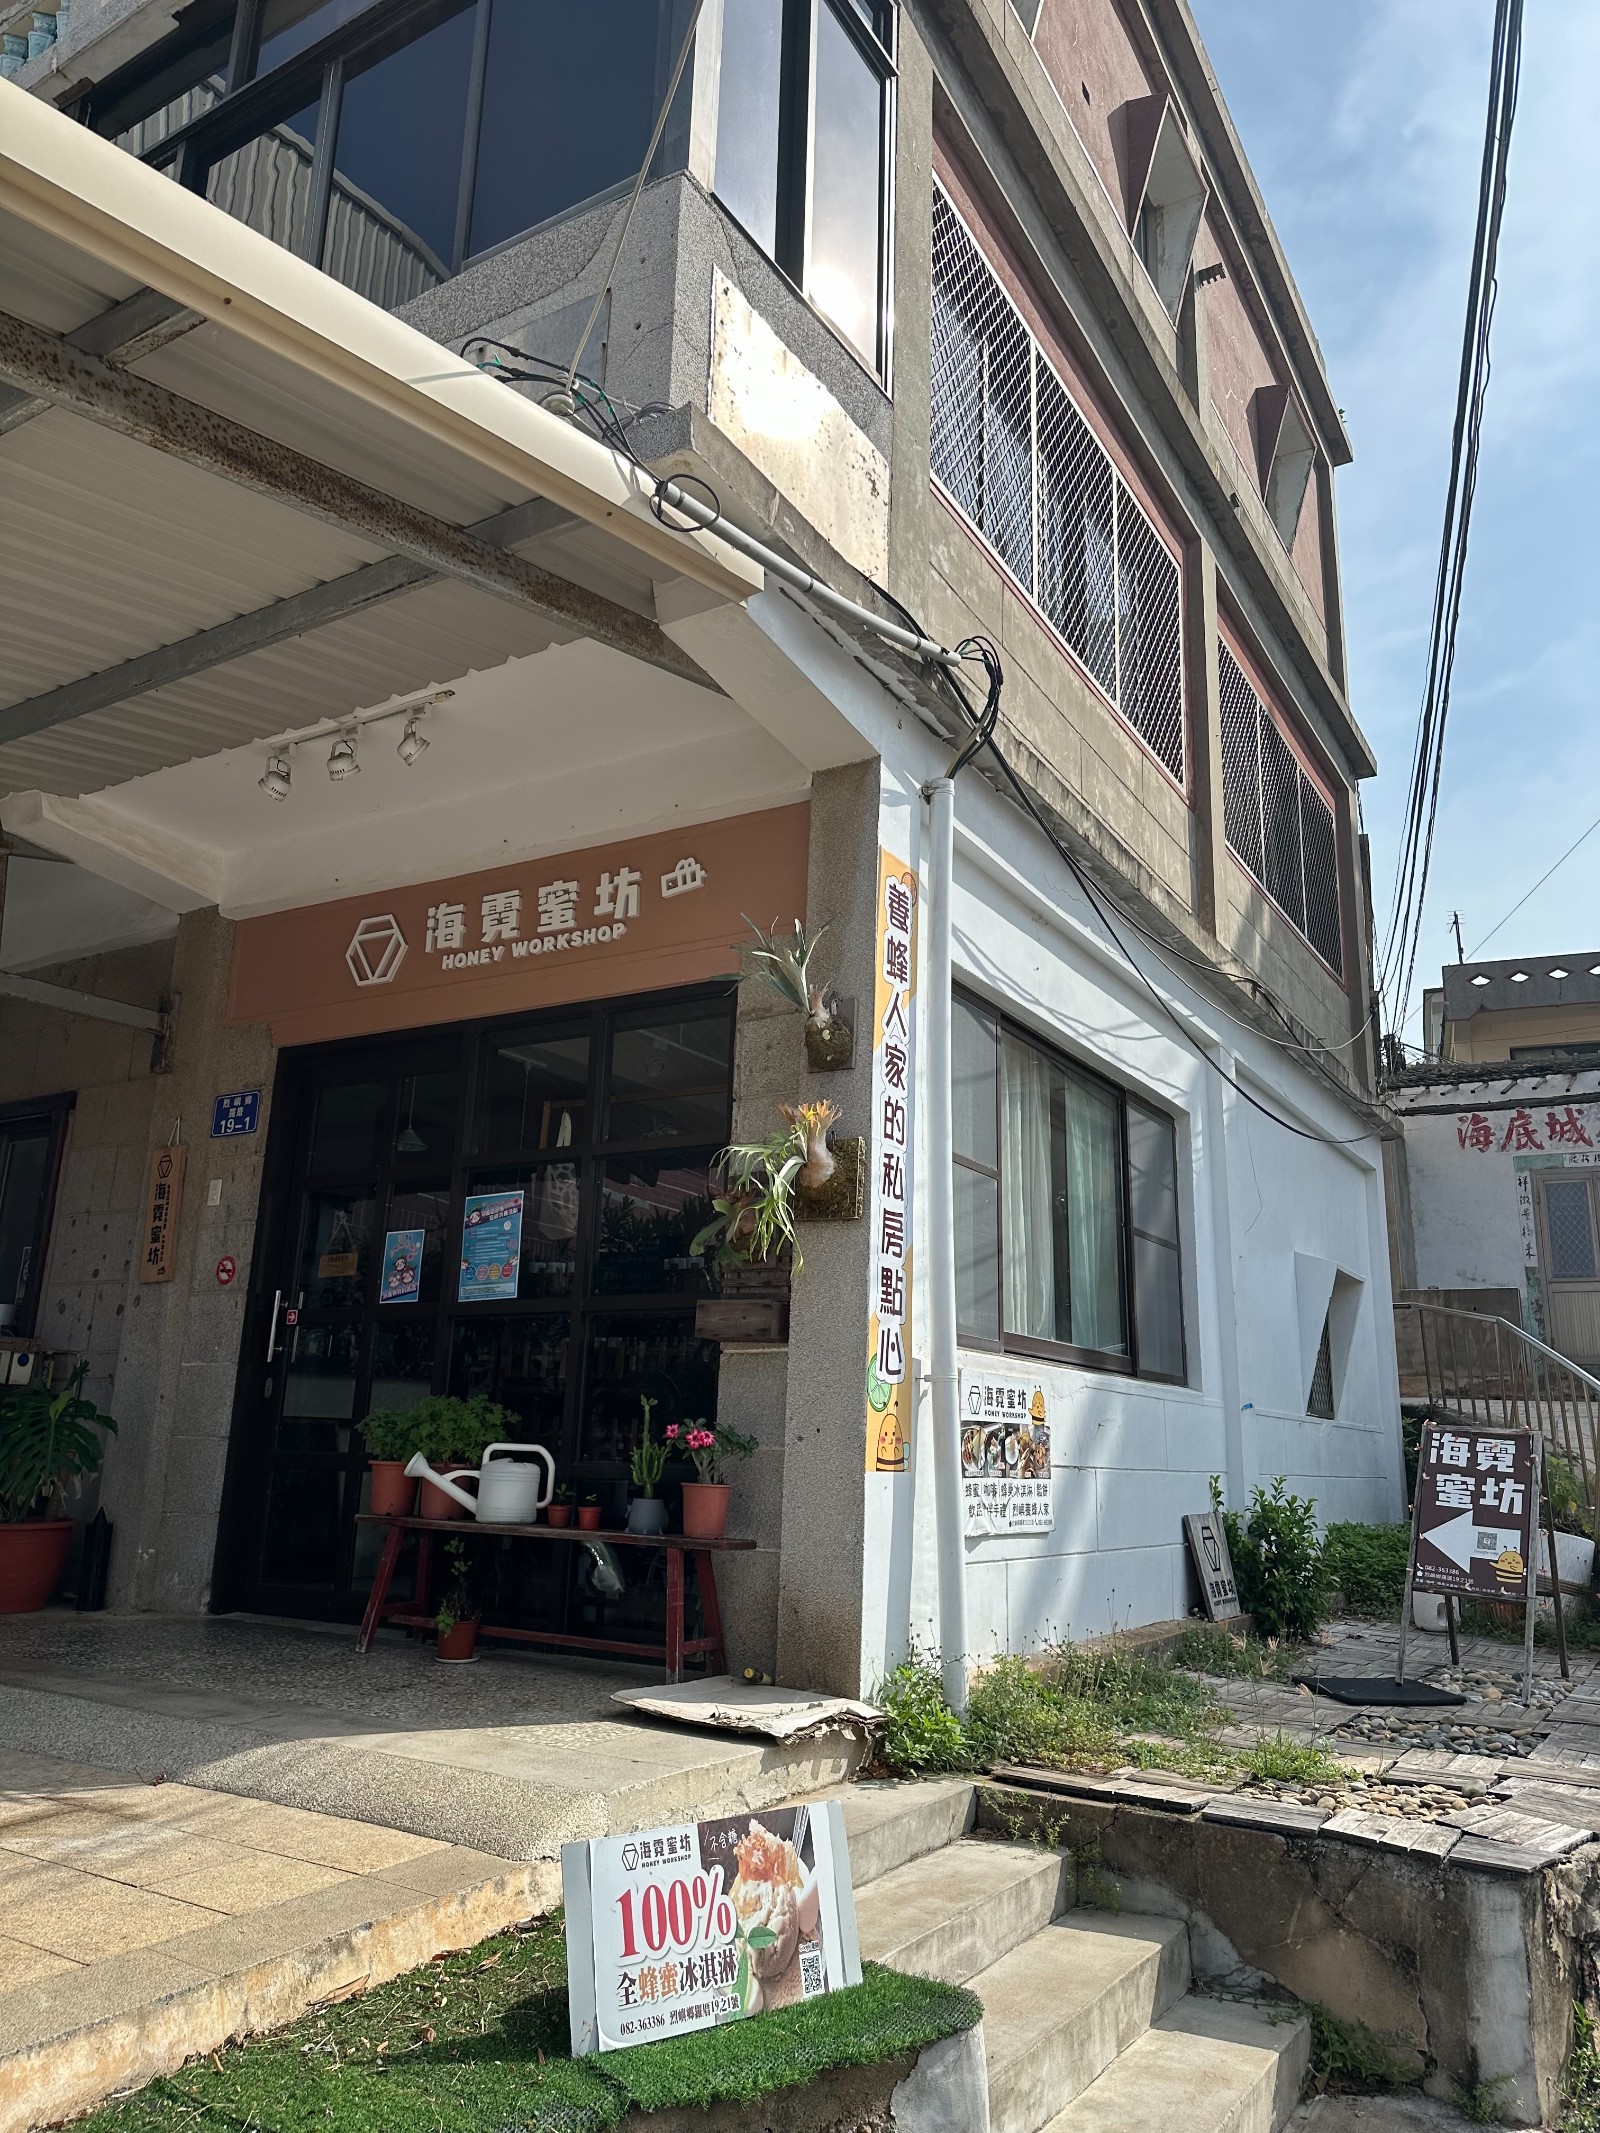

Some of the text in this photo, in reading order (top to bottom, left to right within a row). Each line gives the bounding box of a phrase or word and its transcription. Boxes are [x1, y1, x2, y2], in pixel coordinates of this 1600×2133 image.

[425, 867, 642, 953] 海霓蜜坊
[441, 922, 627, 970] HONEY WORKSHOP
[220, 1116, 250, 1134] 19-1
[879, 884, 910, 1376] 養蜂人家的私房點心
[1457, 1107, 1594, 1152] 海底城
[147, 1183, 167, 1266] 海霓蜜坊
[984, 1385, 1027, 1410] 海霓蜜坊
[984, 1410, 1027, 1419] HONEY WORKSHOP
[1429, 1432, 1516, 1473] 海霓
[965, 1483, 980, 1498] 蜂蜜
[1435, 1472, 1526, 1515] 蜜坊
[640, 1834, 692, 1860] 海霓蜜坊
[641, 1853, 692, 1869] HONEY WORKSHOP
[616, 1872, 732, 1958] 100%
[617, 1948, 737, 2006] 全蜂蜜冰淇淋
[620, 2015, 665, 2036] 082-363386
